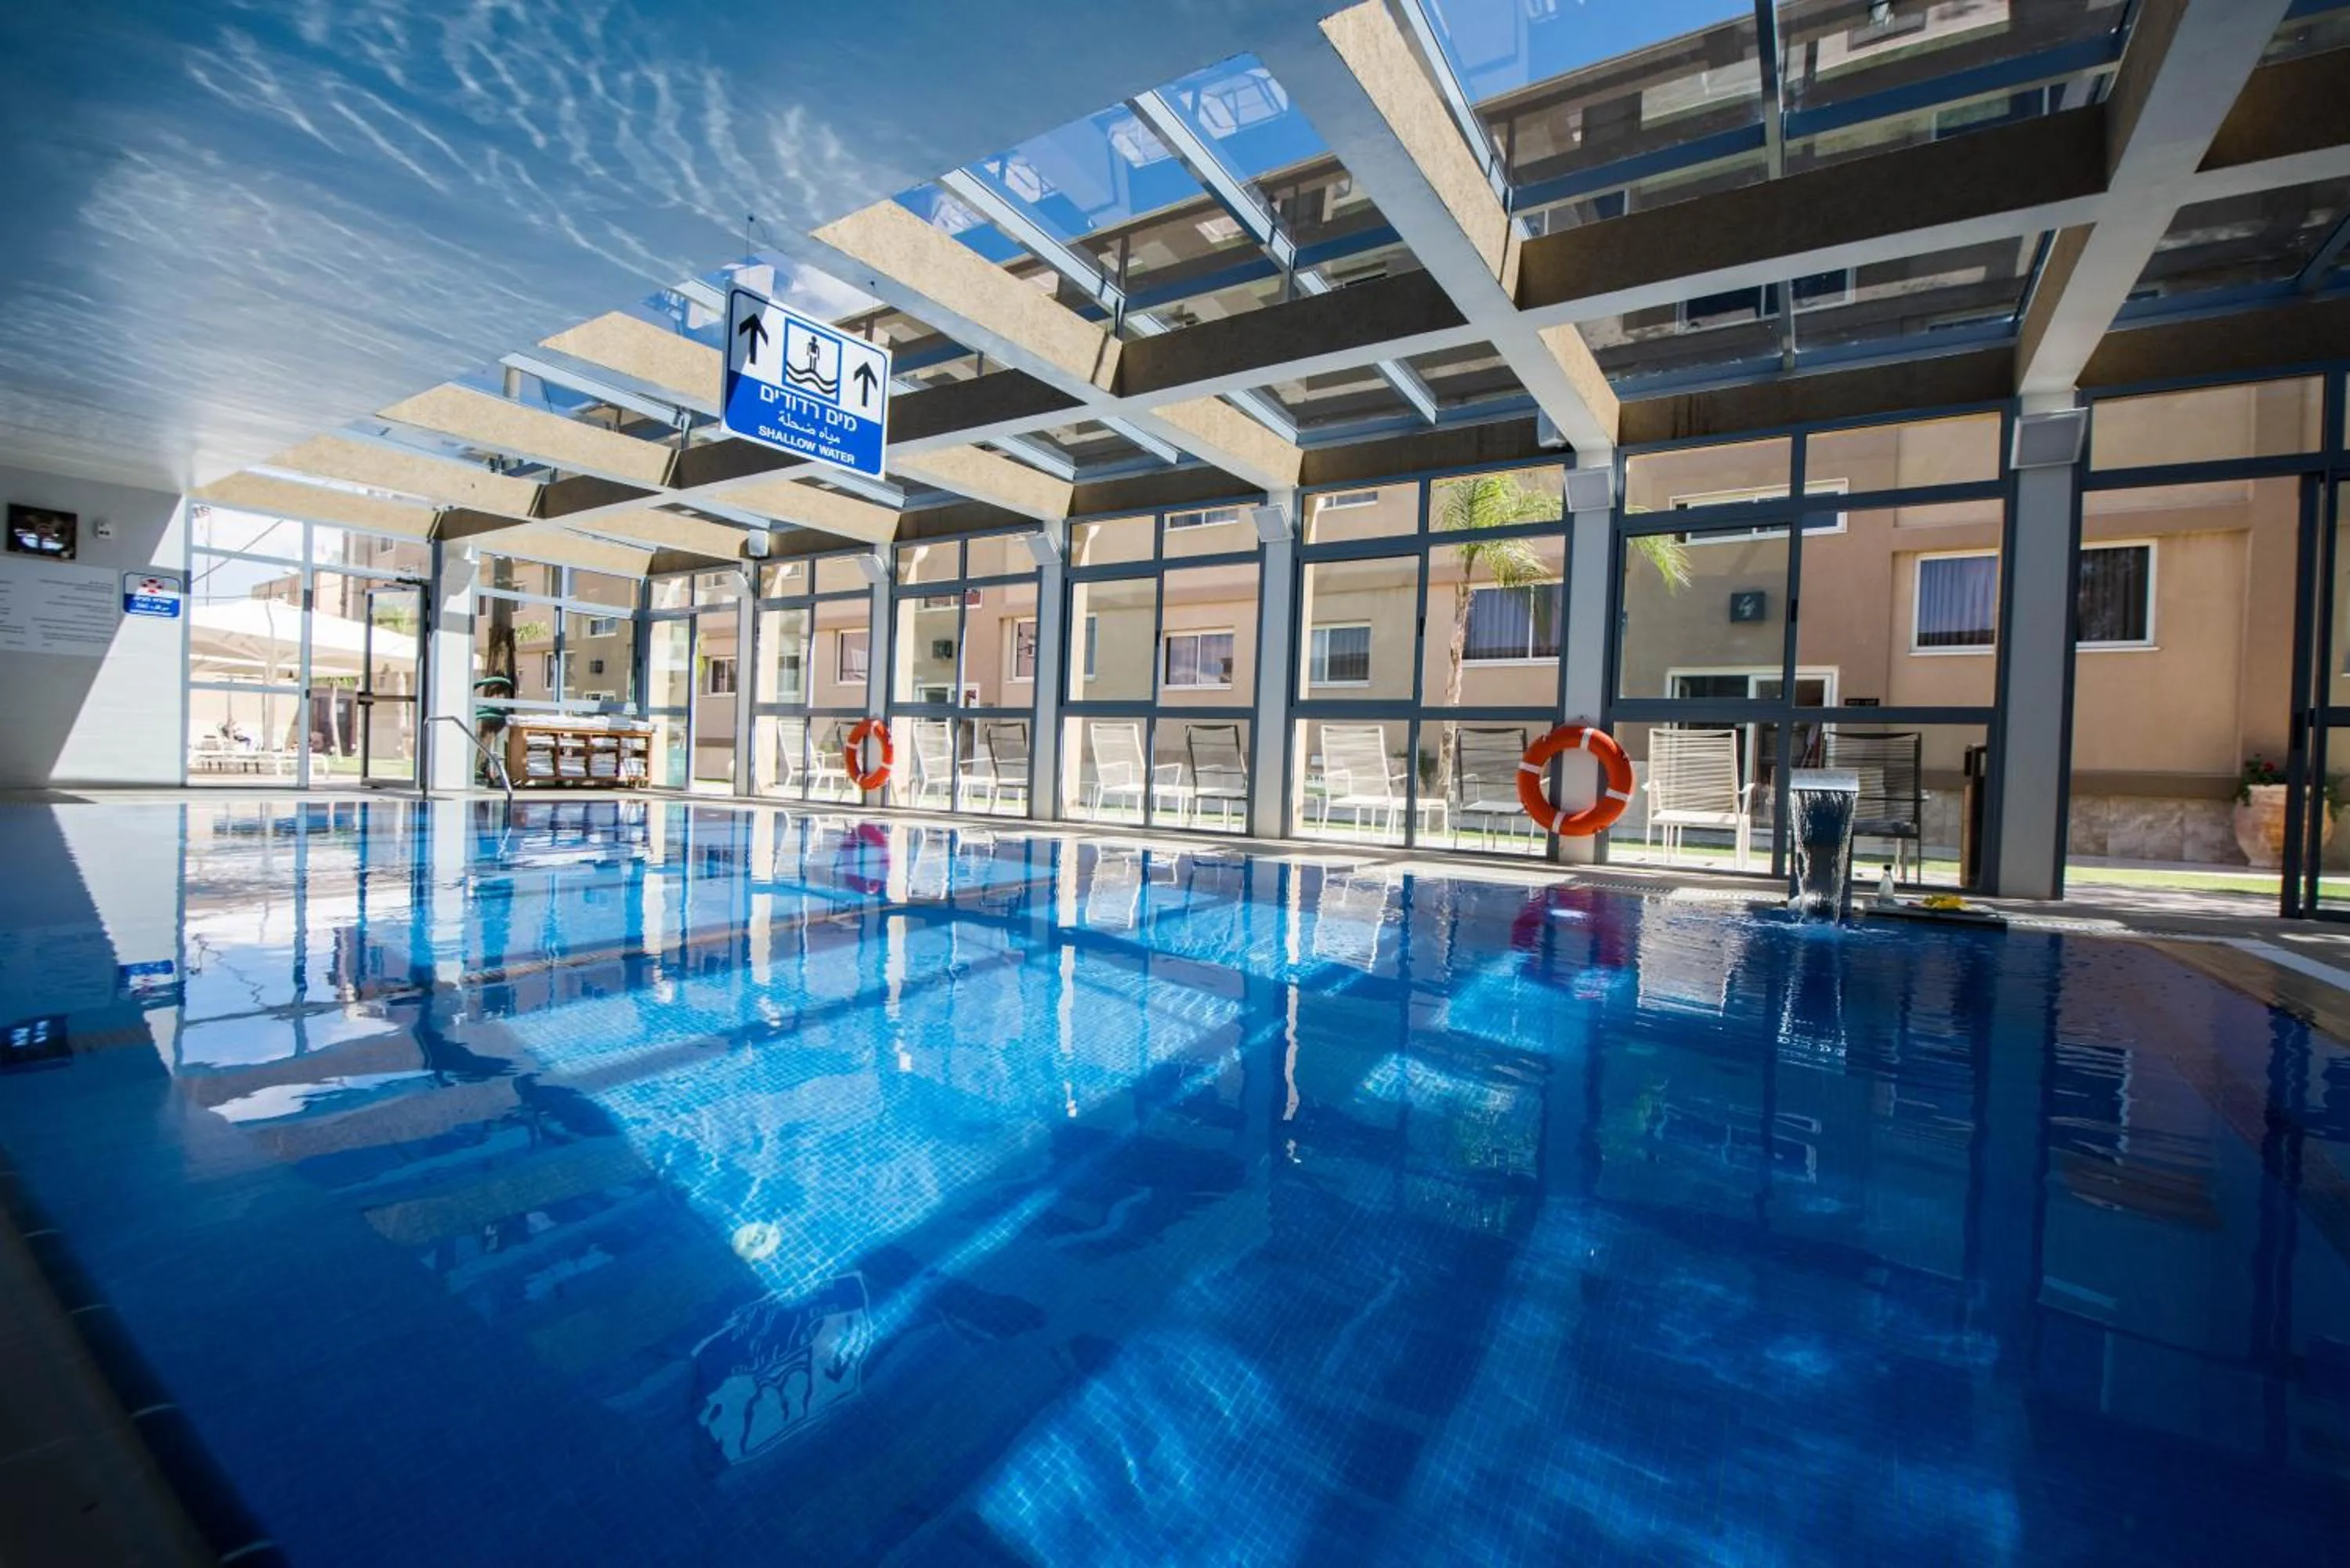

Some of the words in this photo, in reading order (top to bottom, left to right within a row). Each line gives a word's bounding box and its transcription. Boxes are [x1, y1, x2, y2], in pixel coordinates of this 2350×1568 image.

[760, 384, 819, 419] רדודים
[826, 408, 857, 432] מים
[758, 425, 816, 451] SHALLOW
[819, 444, 855, 464] WATER
[819, 426, 841, 444] مياه
